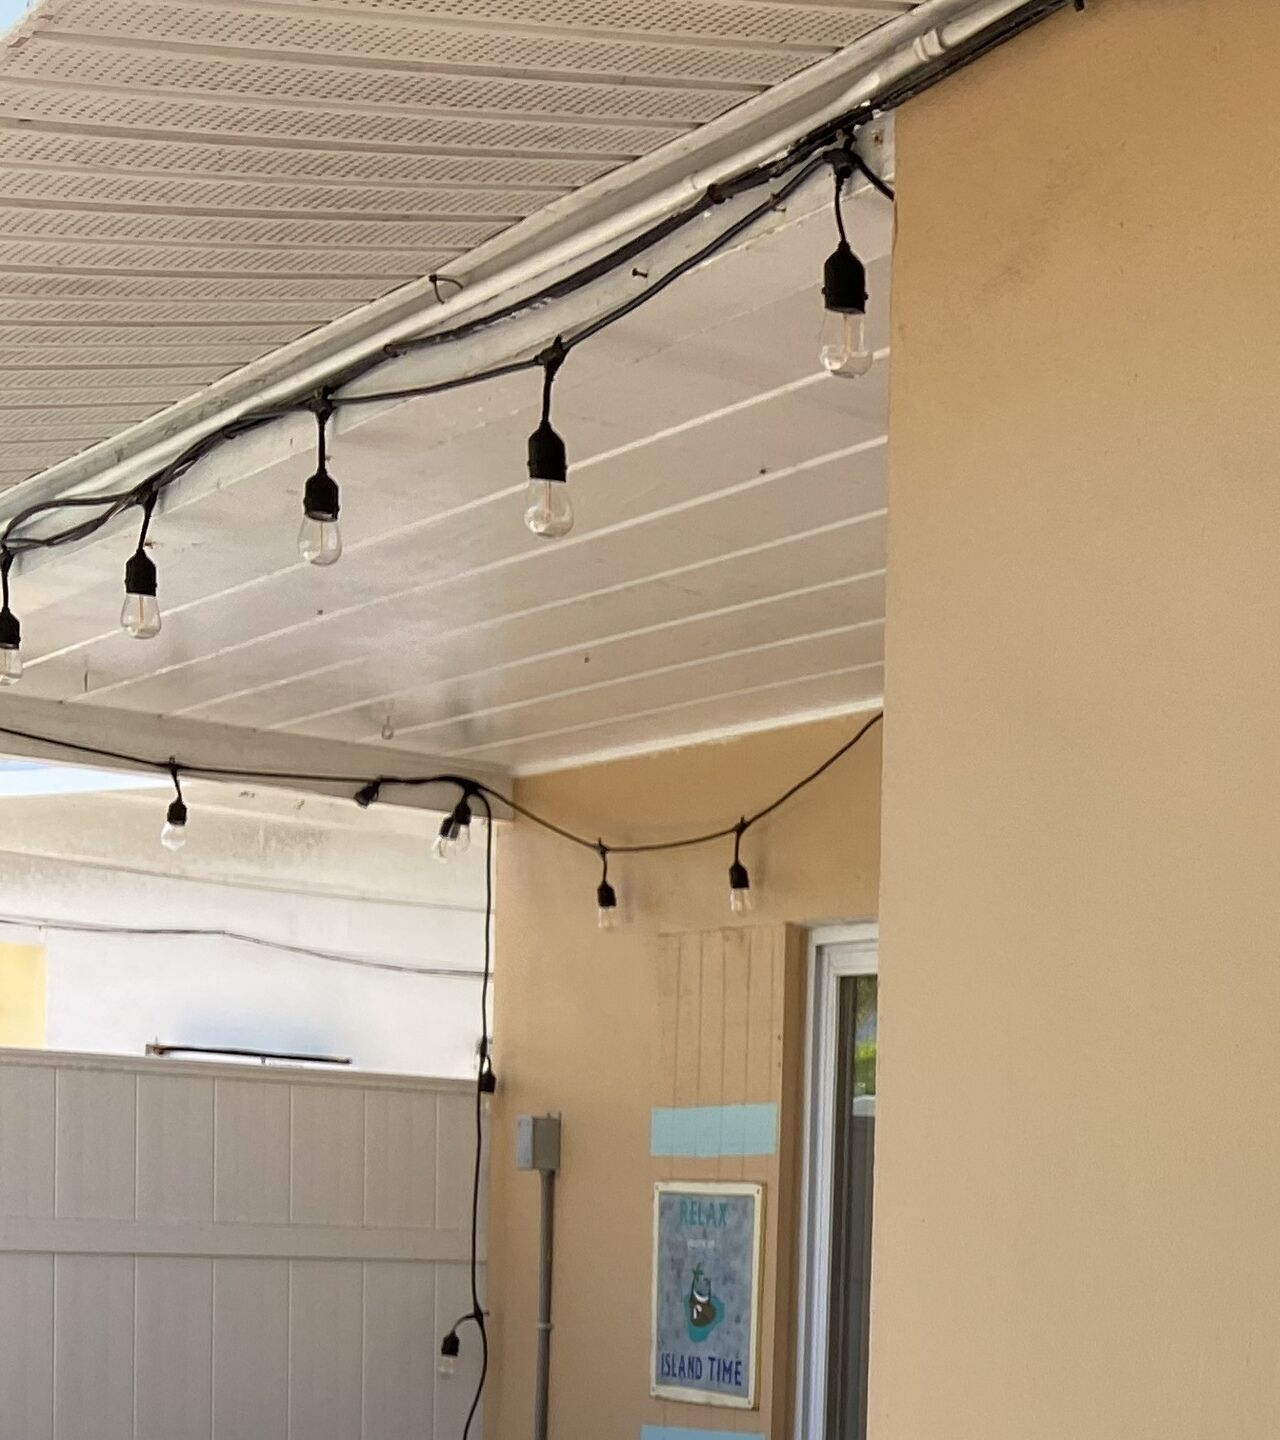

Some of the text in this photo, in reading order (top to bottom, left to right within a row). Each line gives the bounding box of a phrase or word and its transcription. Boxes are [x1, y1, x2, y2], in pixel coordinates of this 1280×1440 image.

[680, 1200, 728, 1227] RELAX
[661, 1353, 742, 1386] ISLAND TIME
